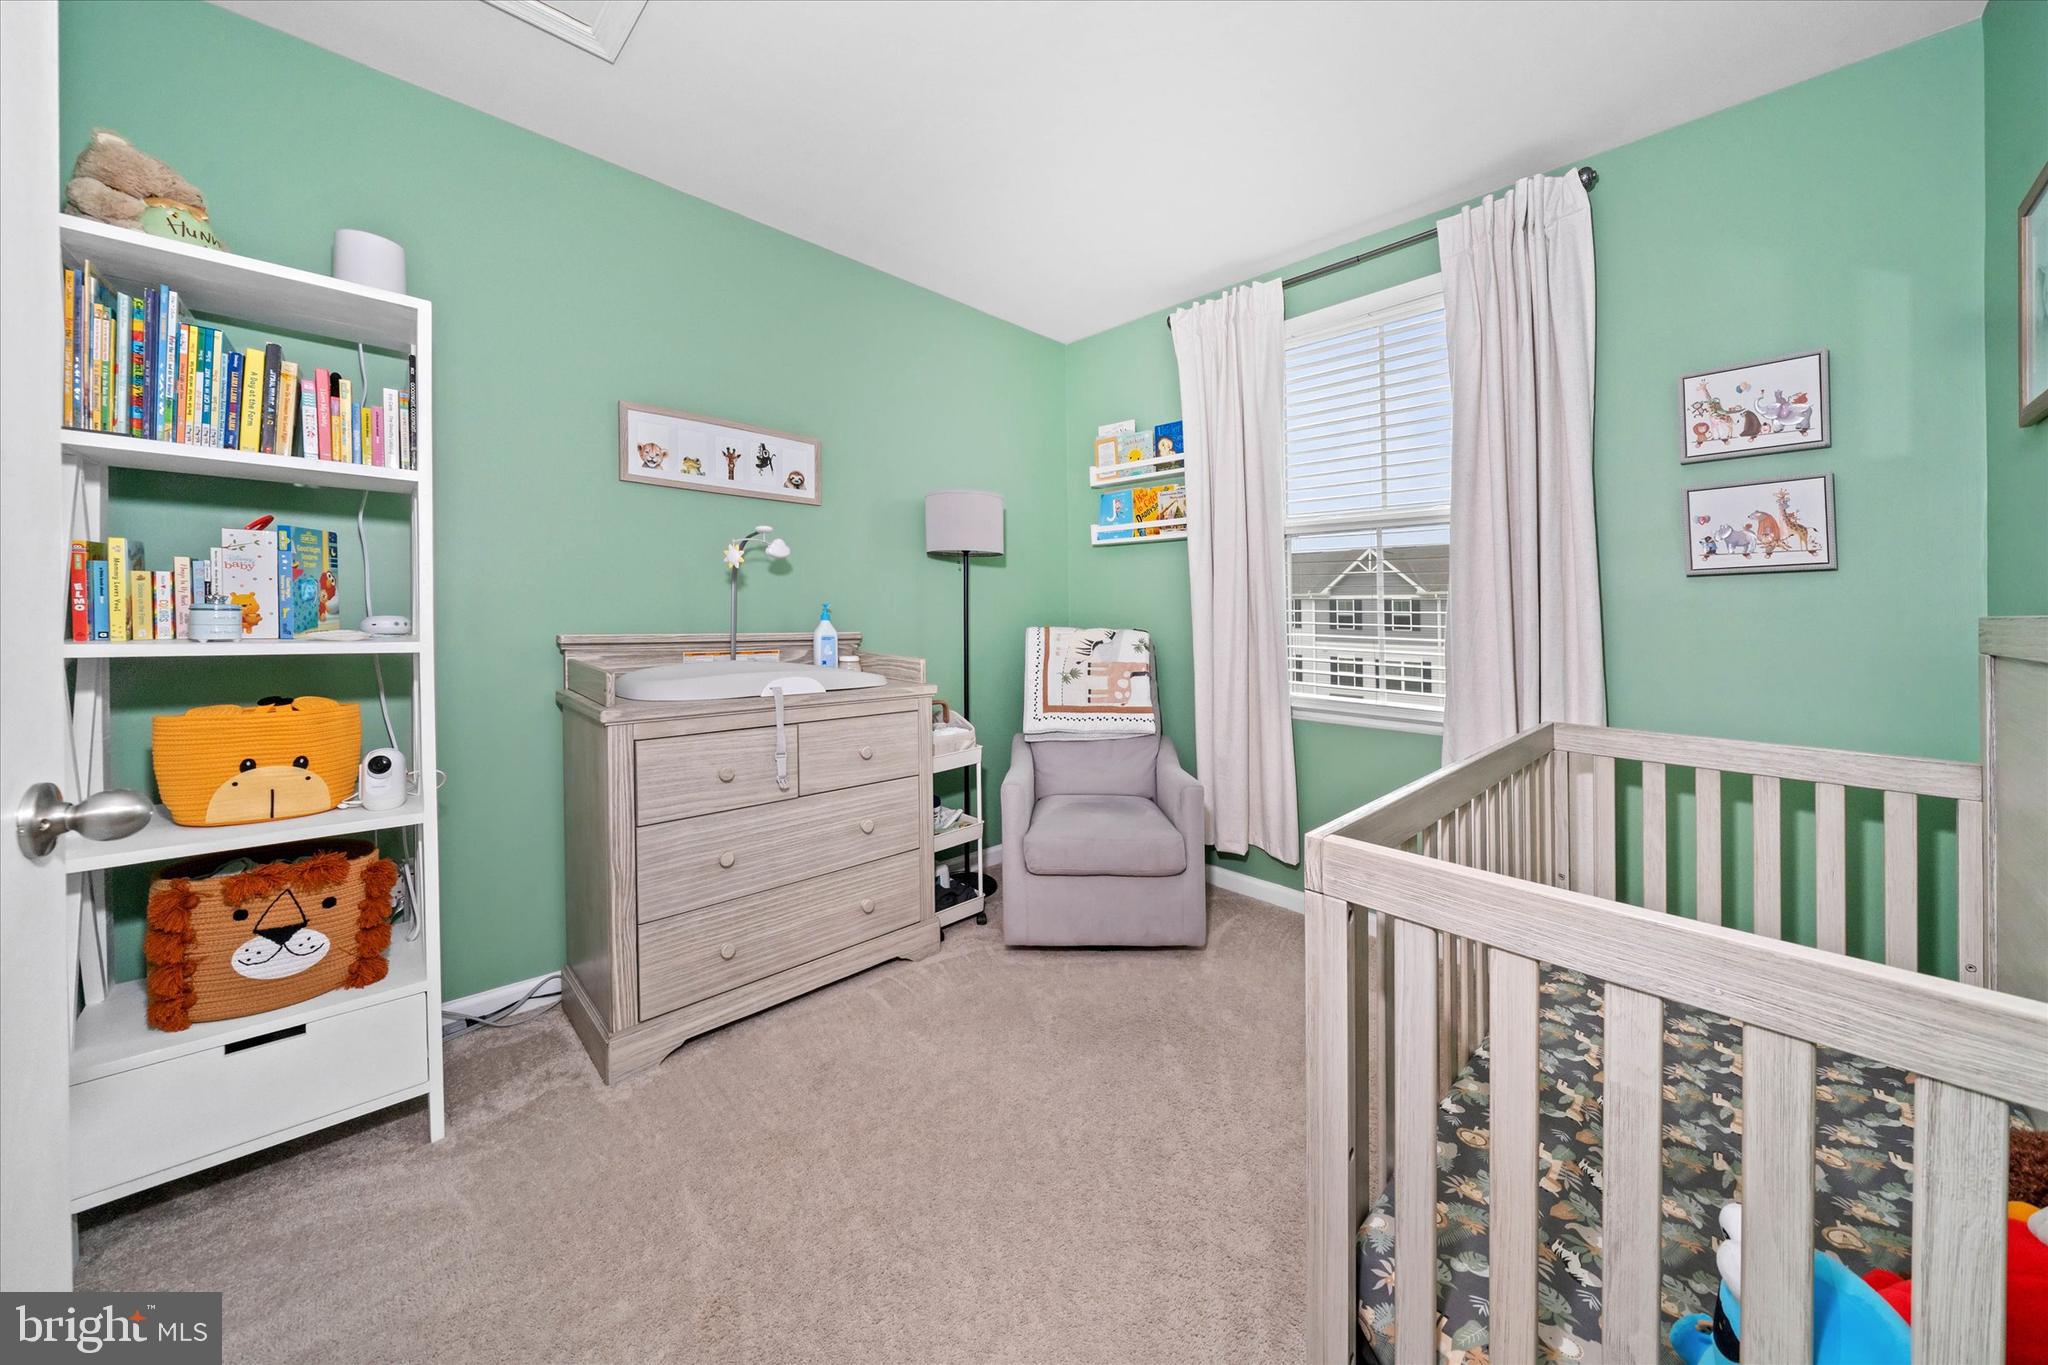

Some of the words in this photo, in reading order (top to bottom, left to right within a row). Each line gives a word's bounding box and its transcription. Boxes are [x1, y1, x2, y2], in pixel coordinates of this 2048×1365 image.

[135, 345, 143, 354] My
[135, 357, 143, 373] First
[134, 375, 143, 393] Busy
[248, 377, 257, 389] Day
[112, 558, 120, 580] Mommy
[224, 560, 256, 572] baby
[74, 583, 85, 611] ELMO
